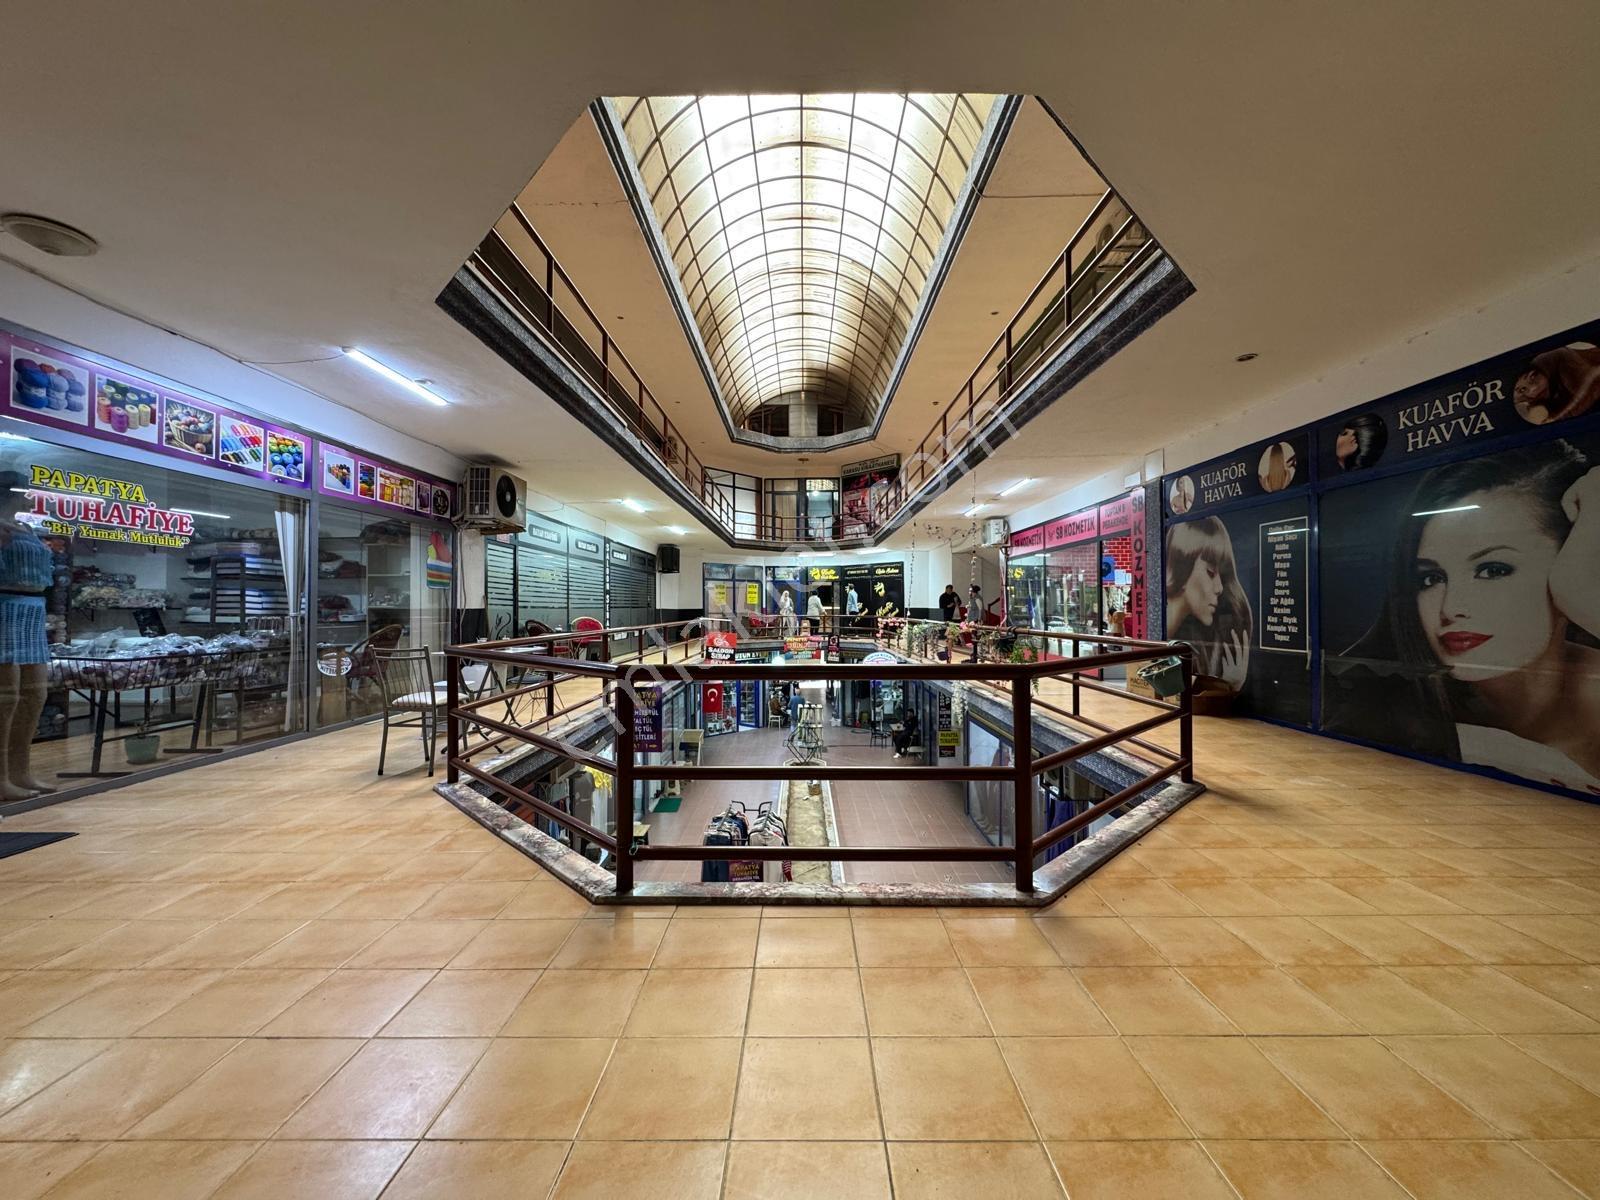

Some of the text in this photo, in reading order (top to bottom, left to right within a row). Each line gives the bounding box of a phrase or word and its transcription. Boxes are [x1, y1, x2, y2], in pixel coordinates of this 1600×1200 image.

[1398, 379, 1506, 430] KUAFÖR
[1407, 411, 1495, 453] HAVVA
[29, 464, 148, 503] PAPATYA
[1200, 462, 1247, 489] KUAFÖR
[1132, 495, 1144, 513] SB
[1204, 481, 1242, 504] HAVVA
[24, 488, 195, 536] TUHAFİYE
[78, 524, 127, 541] Yumak
[1056, 515, 1095, 540] SB KOZMETİK
